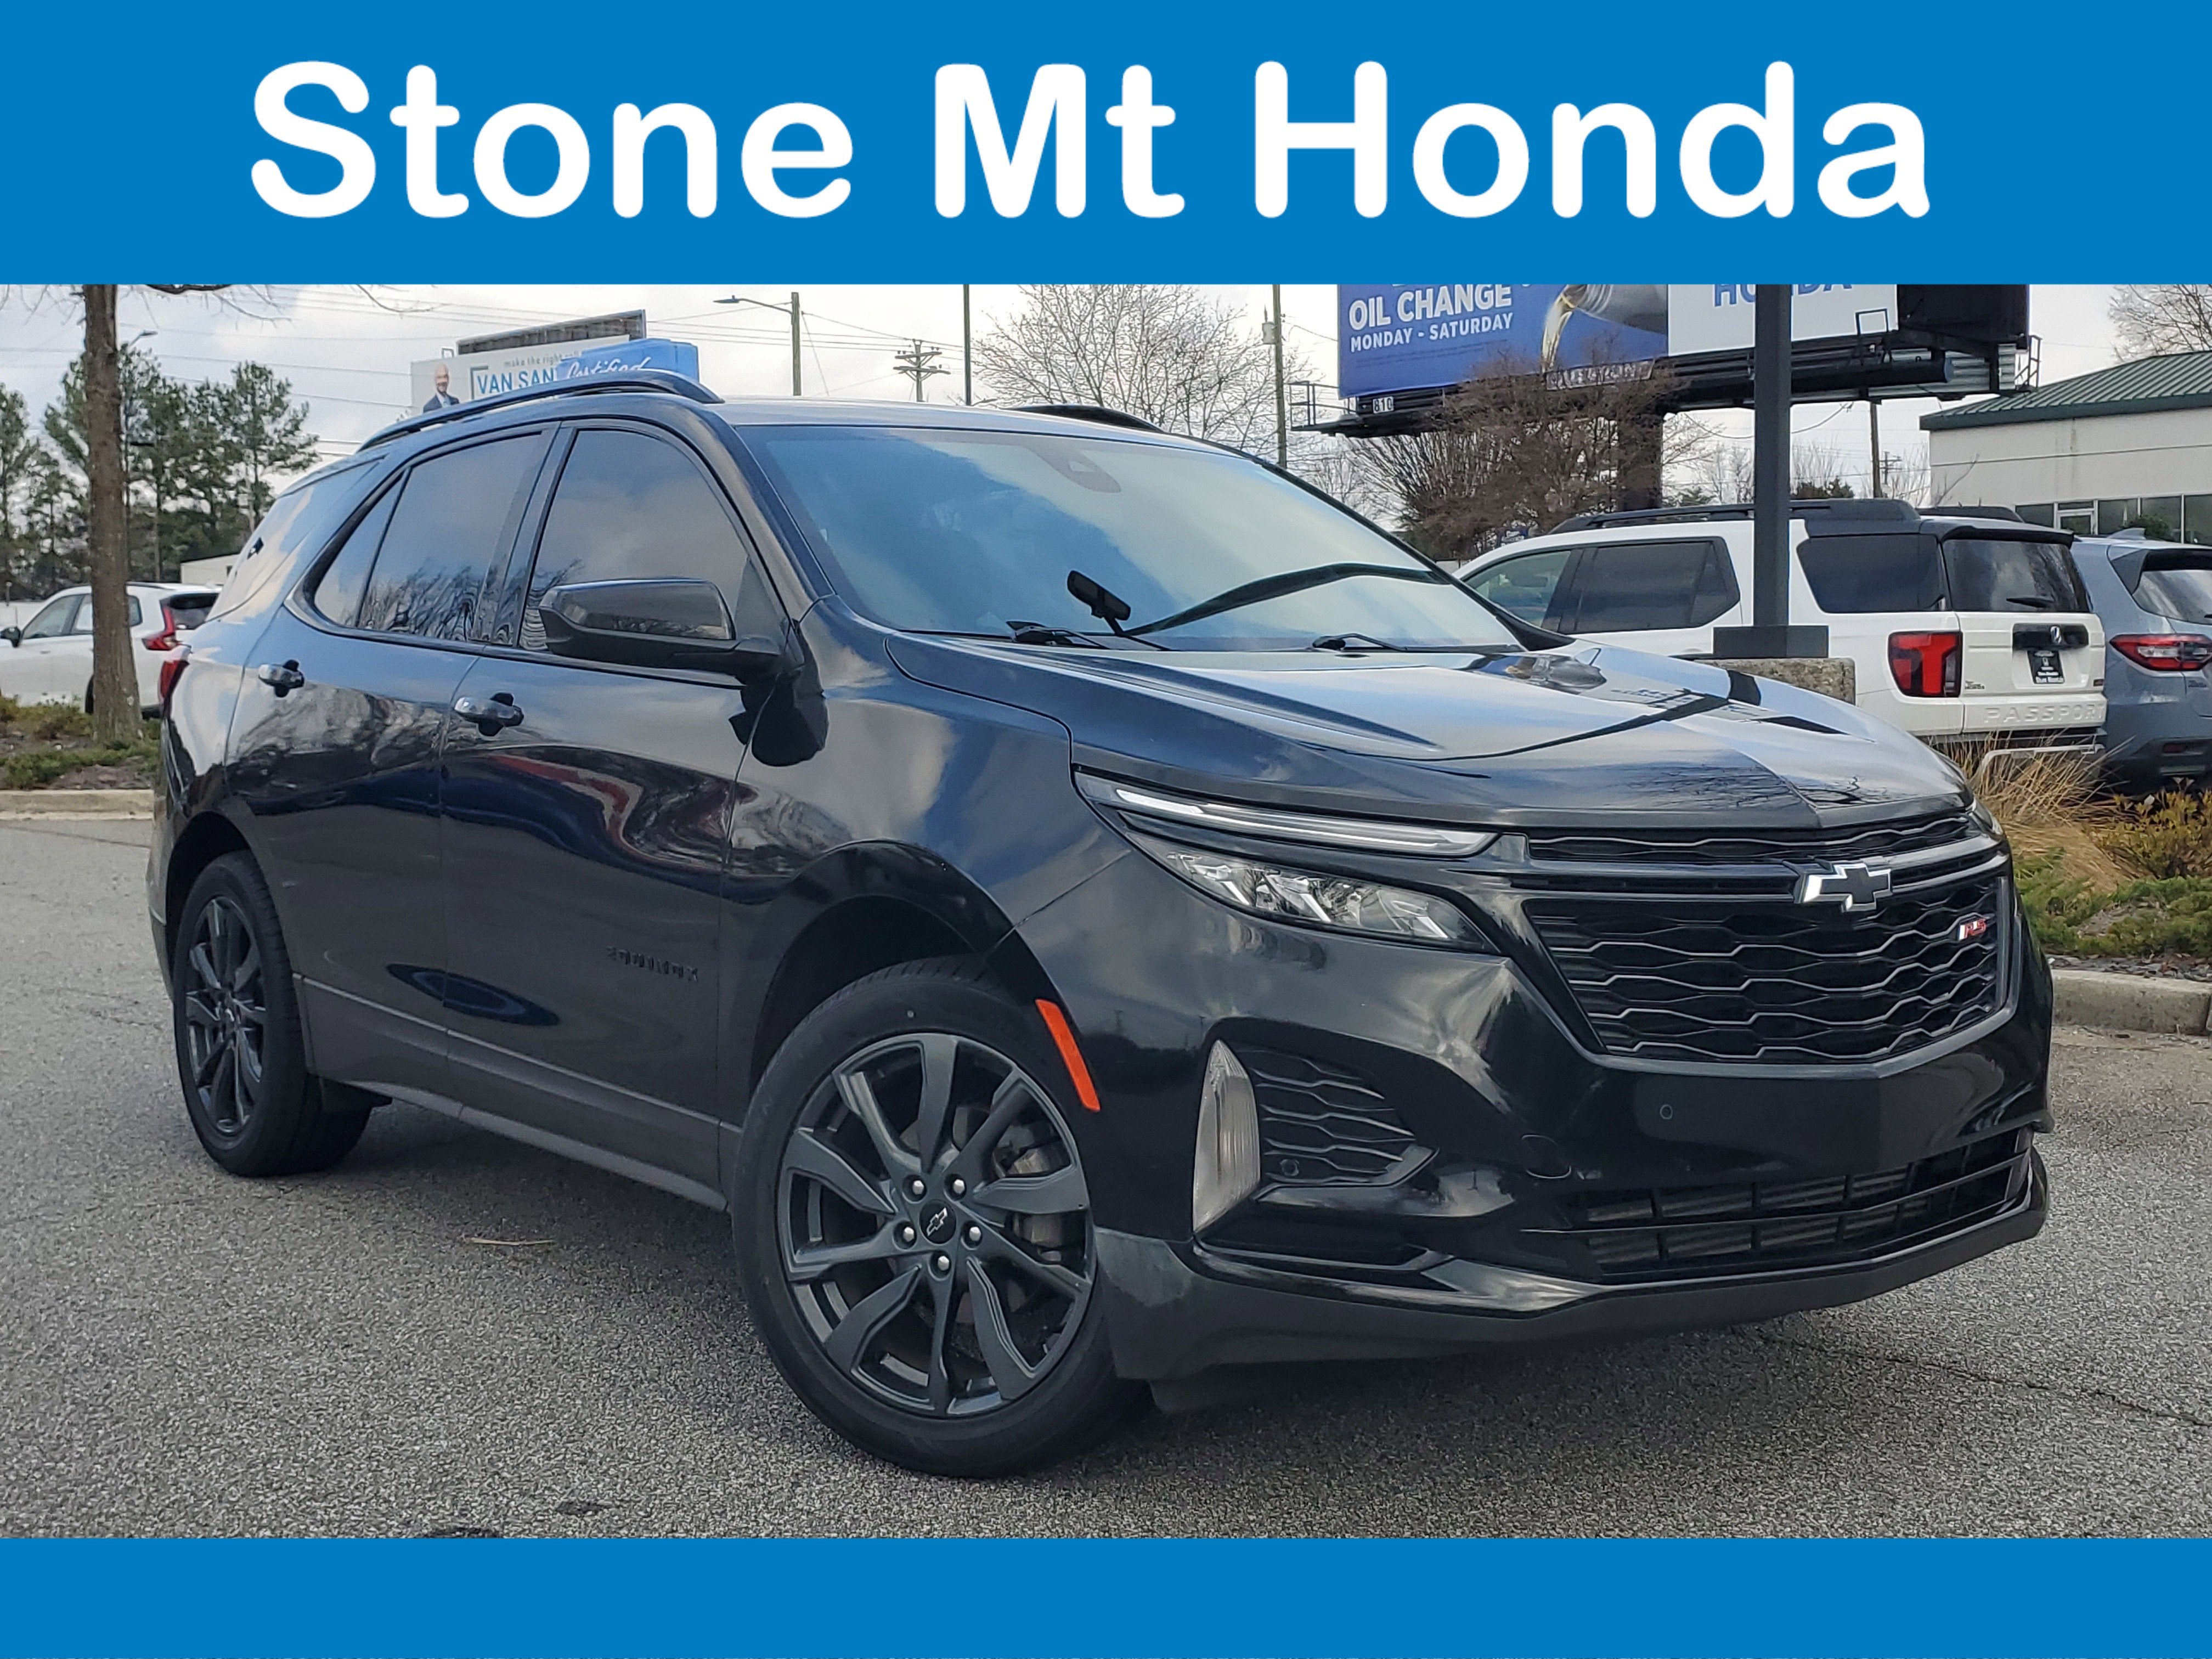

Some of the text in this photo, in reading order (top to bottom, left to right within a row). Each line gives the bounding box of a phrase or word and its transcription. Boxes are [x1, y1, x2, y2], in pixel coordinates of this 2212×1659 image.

[1349, 284, 1512, 330] OIL CHANGE
[1350, 328, 1413, 353] MONDAY
[1429, 312, 1514, 341] SATURDAY
[527, 356, 540, 365] the
[477, 373, 512, 394] VAN
[1374, 397, 1392, 412] 810
[1984, 704, 2105, 723] PASSPORT
[1959, 918, 1987, 940] RS
